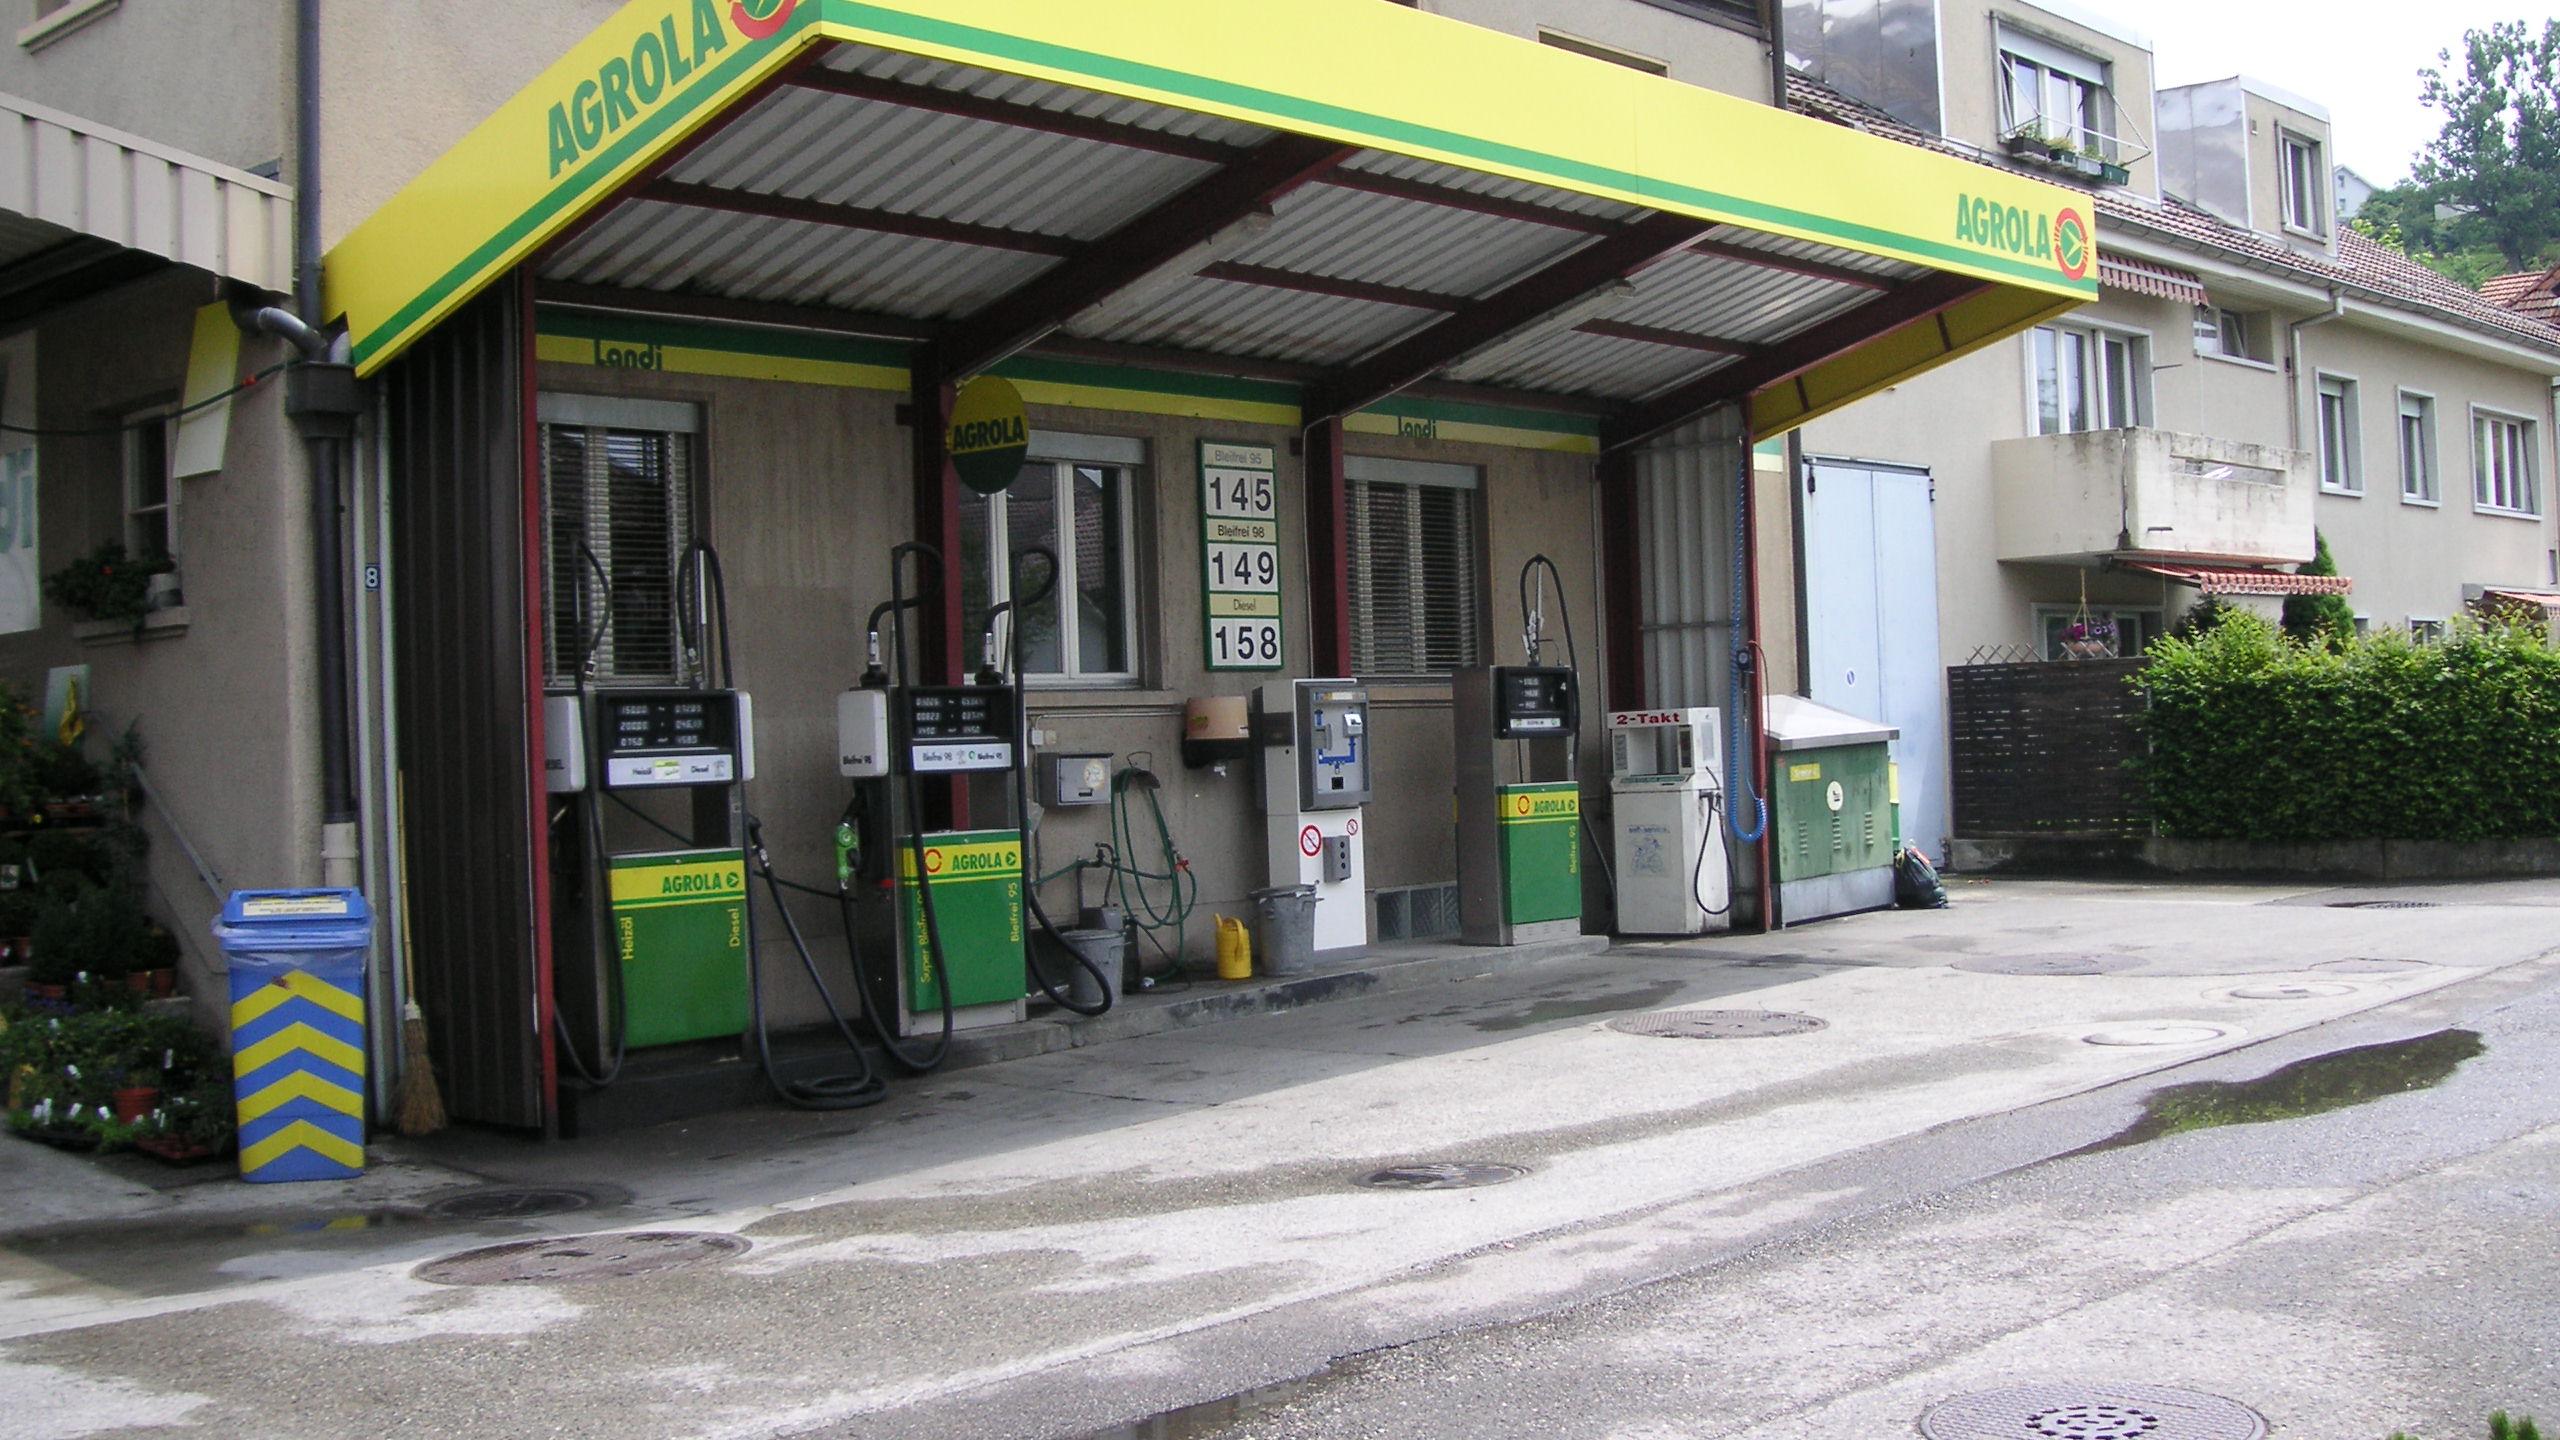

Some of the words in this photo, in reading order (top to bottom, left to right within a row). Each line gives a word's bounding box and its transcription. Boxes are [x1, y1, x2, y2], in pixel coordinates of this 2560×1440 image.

[548, 0, 728, 180] AGROLA
[1956, 193, 2052, 261] AGROLA
[593, 338, 662, 371] Landi
[953, 415, 1026, 451] AGROLA
[1397, 415, 1437, 440] Landi
[1215, 450, 1247, 464] Bleifrei
[1249, 453, 1262, 465] 95
[1209, 476, 1272, 512] 145
[1217, 524, 1250, 538] Bleifrei
[1252, 526, 1265, 538] 98
[366, 567, 379, 588] 8
[1212, 551, 1274, 585] 149
[1233, 598, 1256, 611] Diesel
[1215, 626, 1278, 660] 158
[1616, 712, 1680, 725] 2-Takt
[1534, 799, 1566, 813] AGROLA
[952, 851, 1002, 871] AGROLA
[662, 872, 722, 894] AGROLA
[1008, 882, 1018, 898] 95
[620, 916, 634, 960] Heizöl
[728, 908, 740, 948] Diesel
[1009, 902, 1020, 942] Bleifrei
[920, 950, 931, 984] Super
